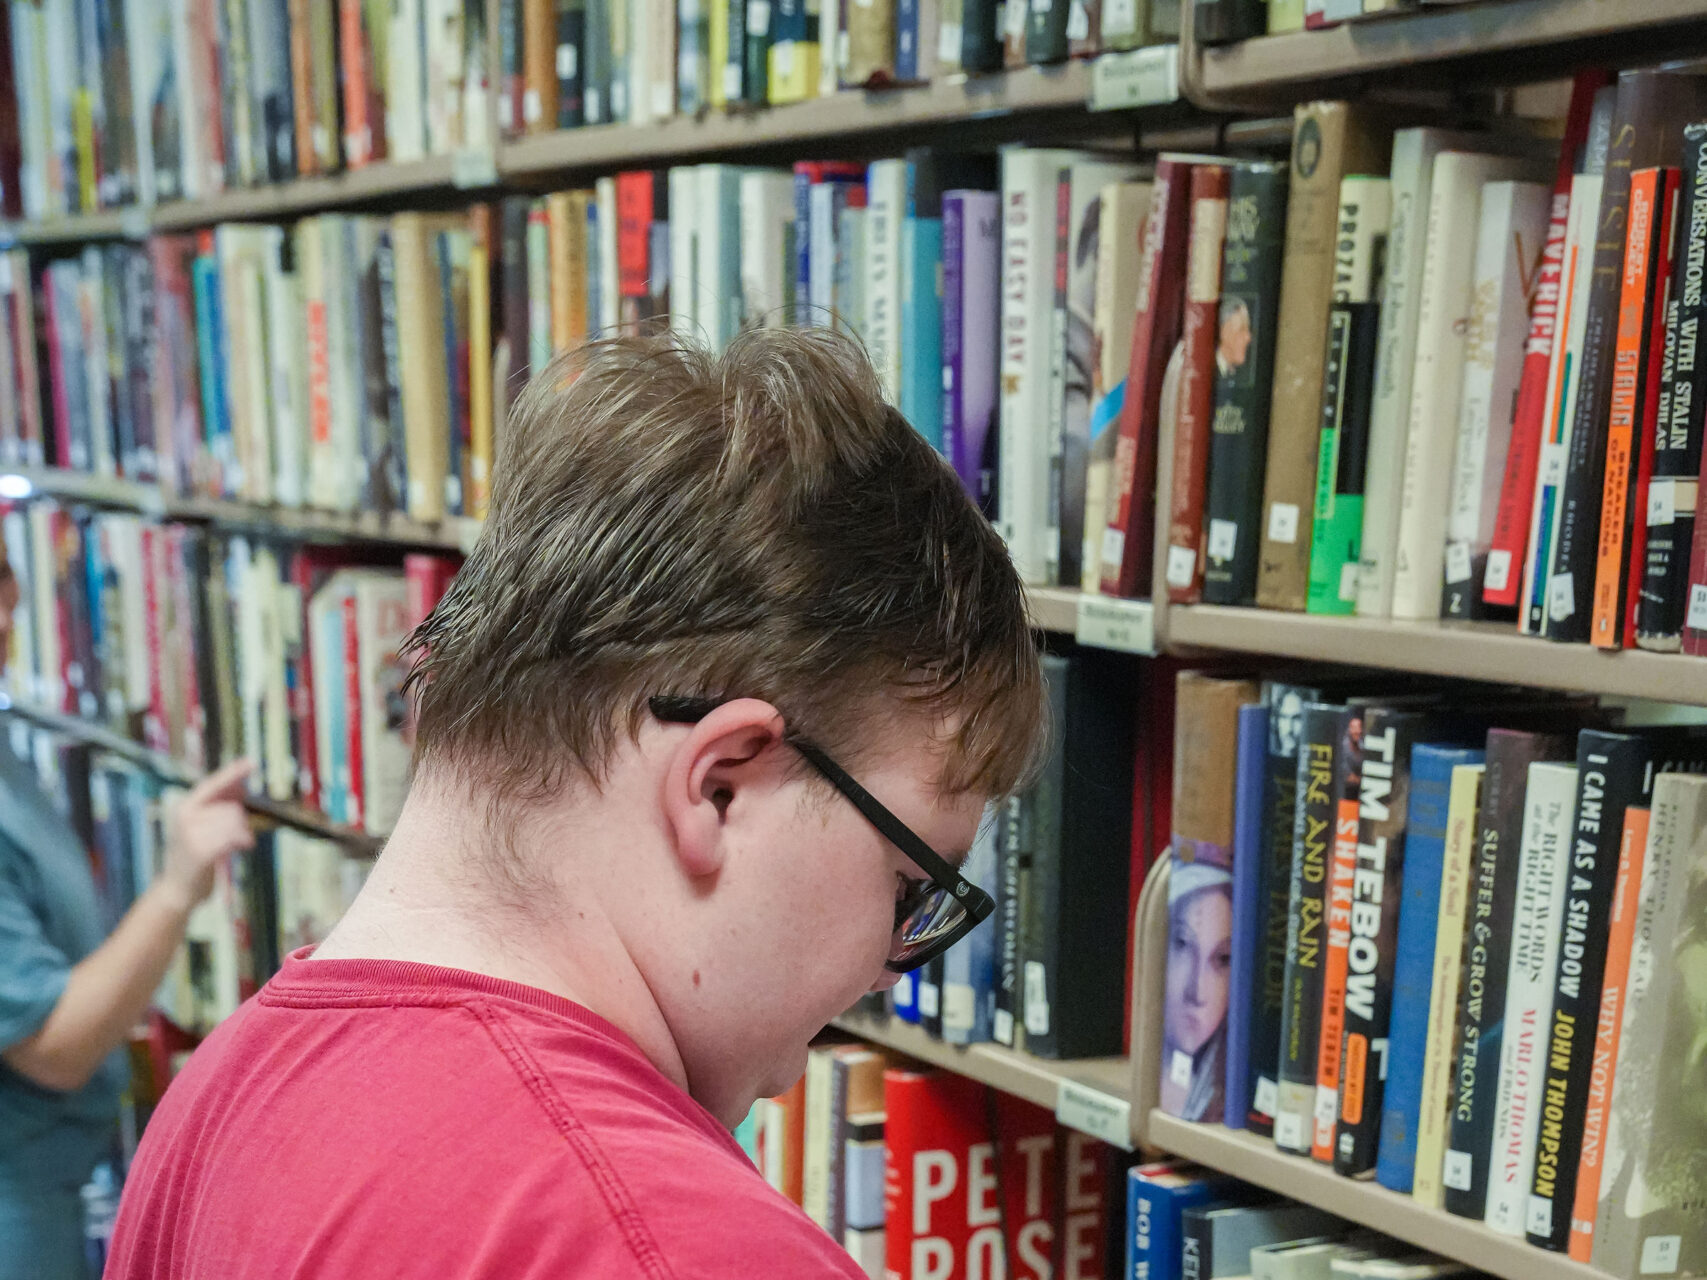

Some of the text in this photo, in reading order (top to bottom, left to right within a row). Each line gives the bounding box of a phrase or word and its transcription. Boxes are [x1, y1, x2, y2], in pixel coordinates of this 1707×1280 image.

[1006, 190, 1028, 365] NO EASY DAY
[1333, 203, 1360, 303] PROZAC
[1526, 194, 1569, 353] MAVERICK
[1626, 188, 1643, 287] CONQUEST
[1636, 200, 1650, 275] ROBERT
[1682, 142, 1707, 308] CONVERSATIONS
[1612, 350, 1638, 426] STALIN
[1653, 300, 1680, 451] MILOVAN DJILAS
[1668, 316, 1699, 451] WITH STALIN
[1602, 438, 1621, 557] OF NATIONS
[1610, 451, 1626, 545] BREAKER
[1298, 742, 1333, 968] FIRE AND RAIN
[1327, 816, 1358, 948] SHAKEN
[1346, 727, 1396, 1021] TIM TEBOW
[1475, 829, 1499, 919] SUFFER
[1521, 847, 1539, 913] RIGHT
[1529, 800, 1562, 985] The RIGHT WORDS
[1557, 752, 1609, 999] I CAME AS A SHADOW
[1465, 942, 1489, 1021] GROW
[1515, 918, 1532, 974] TIME
[1456, 1024, 1481, 1123] STRONG
[1505, 1007, 1537, 1184] MARLO THOMAS
[1536, 1008, 1576, 1198] JOHN THOMPSON
[1582, 985, 1619, 1168] WHY NOT WIN?
[913, 1132, 1101, 1236] PETE
[1136, 1197, 1152, 1250] BOB
